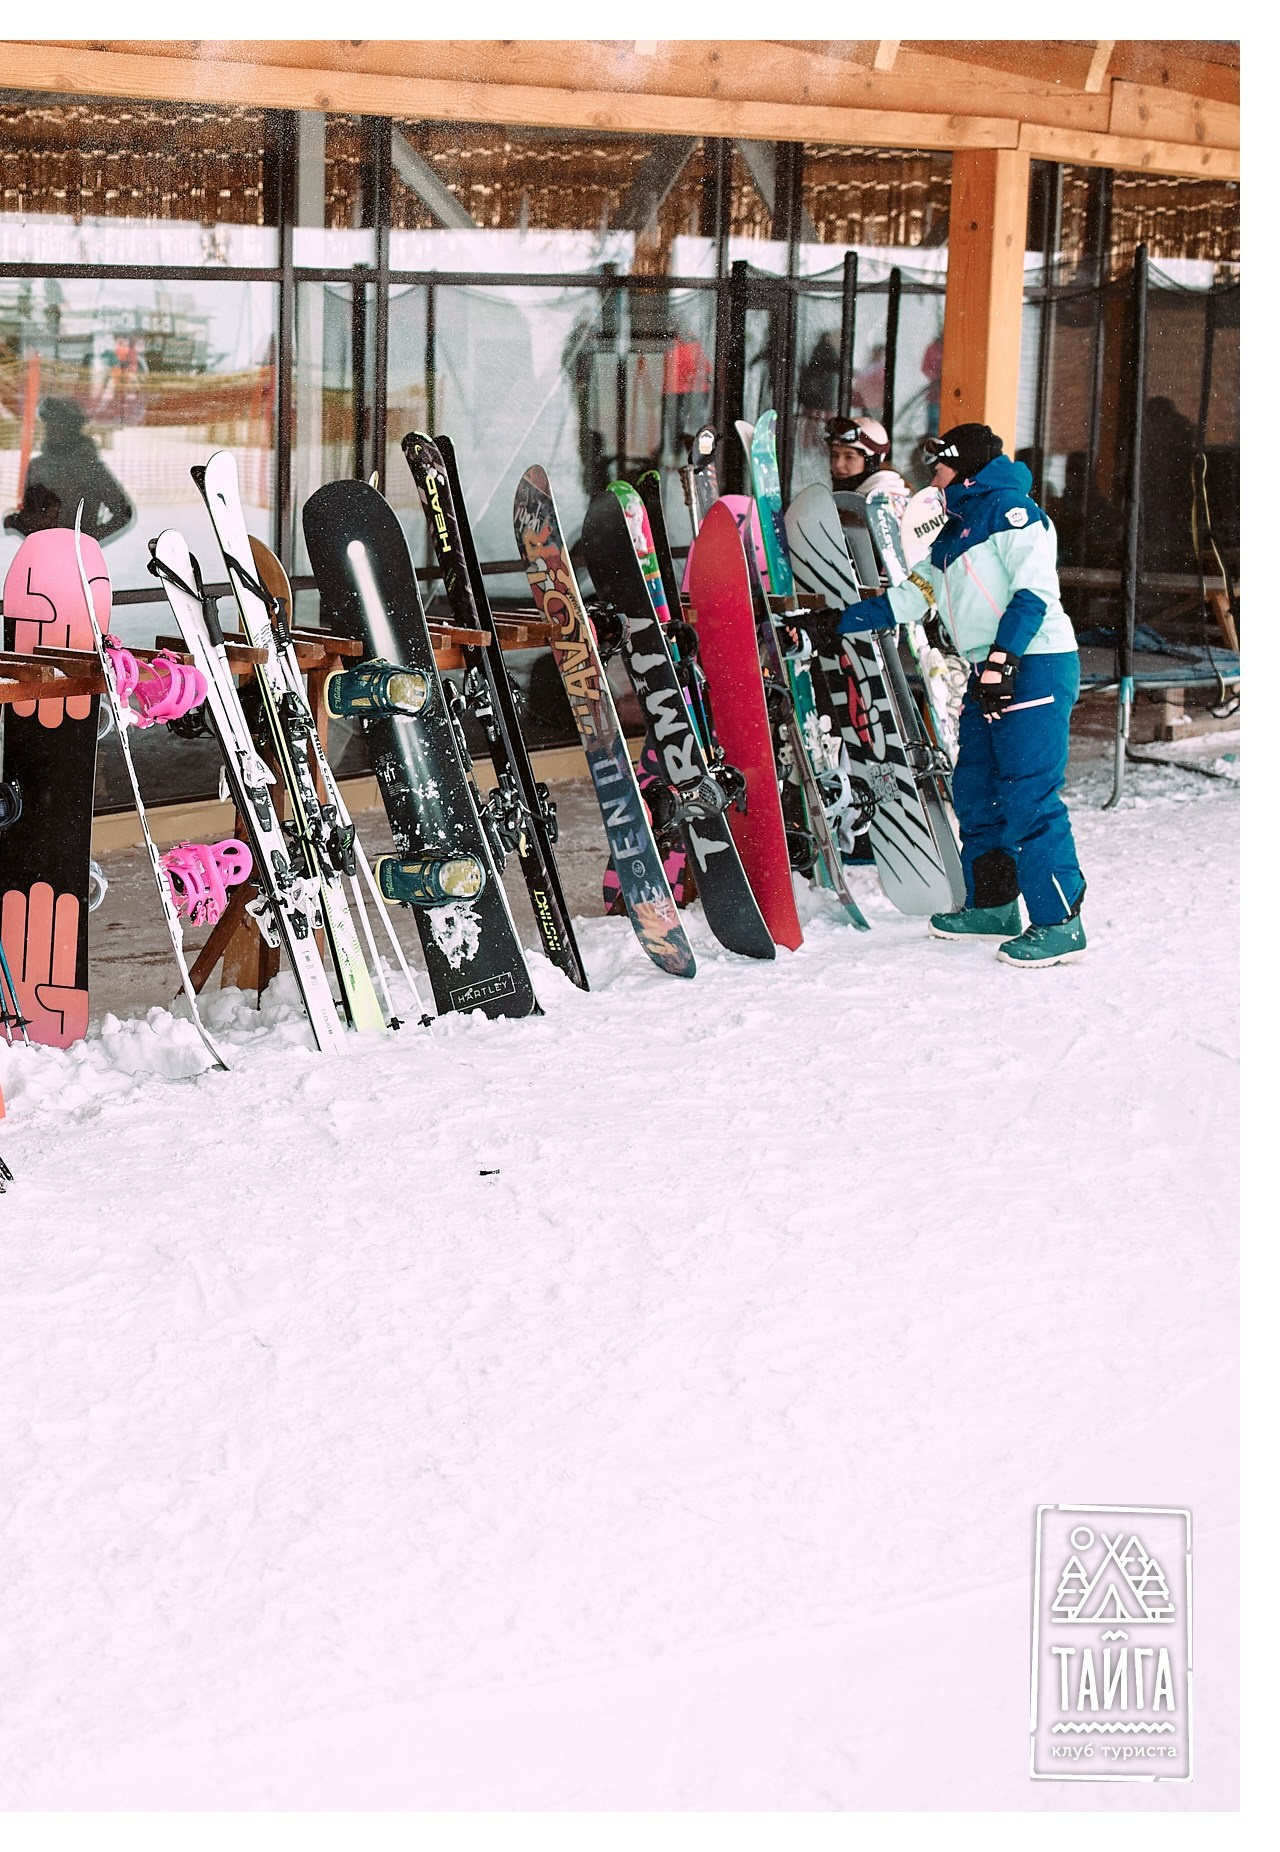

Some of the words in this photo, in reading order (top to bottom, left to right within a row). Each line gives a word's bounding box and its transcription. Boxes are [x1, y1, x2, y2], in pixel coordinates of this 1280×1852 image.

[426, 474, 451, 553] HEAD
[624, 616, 730, 873] TRMIT
[534, 888, 561, 951] INSTINCT
[458, 980, 507, 1004] HARTLEY
